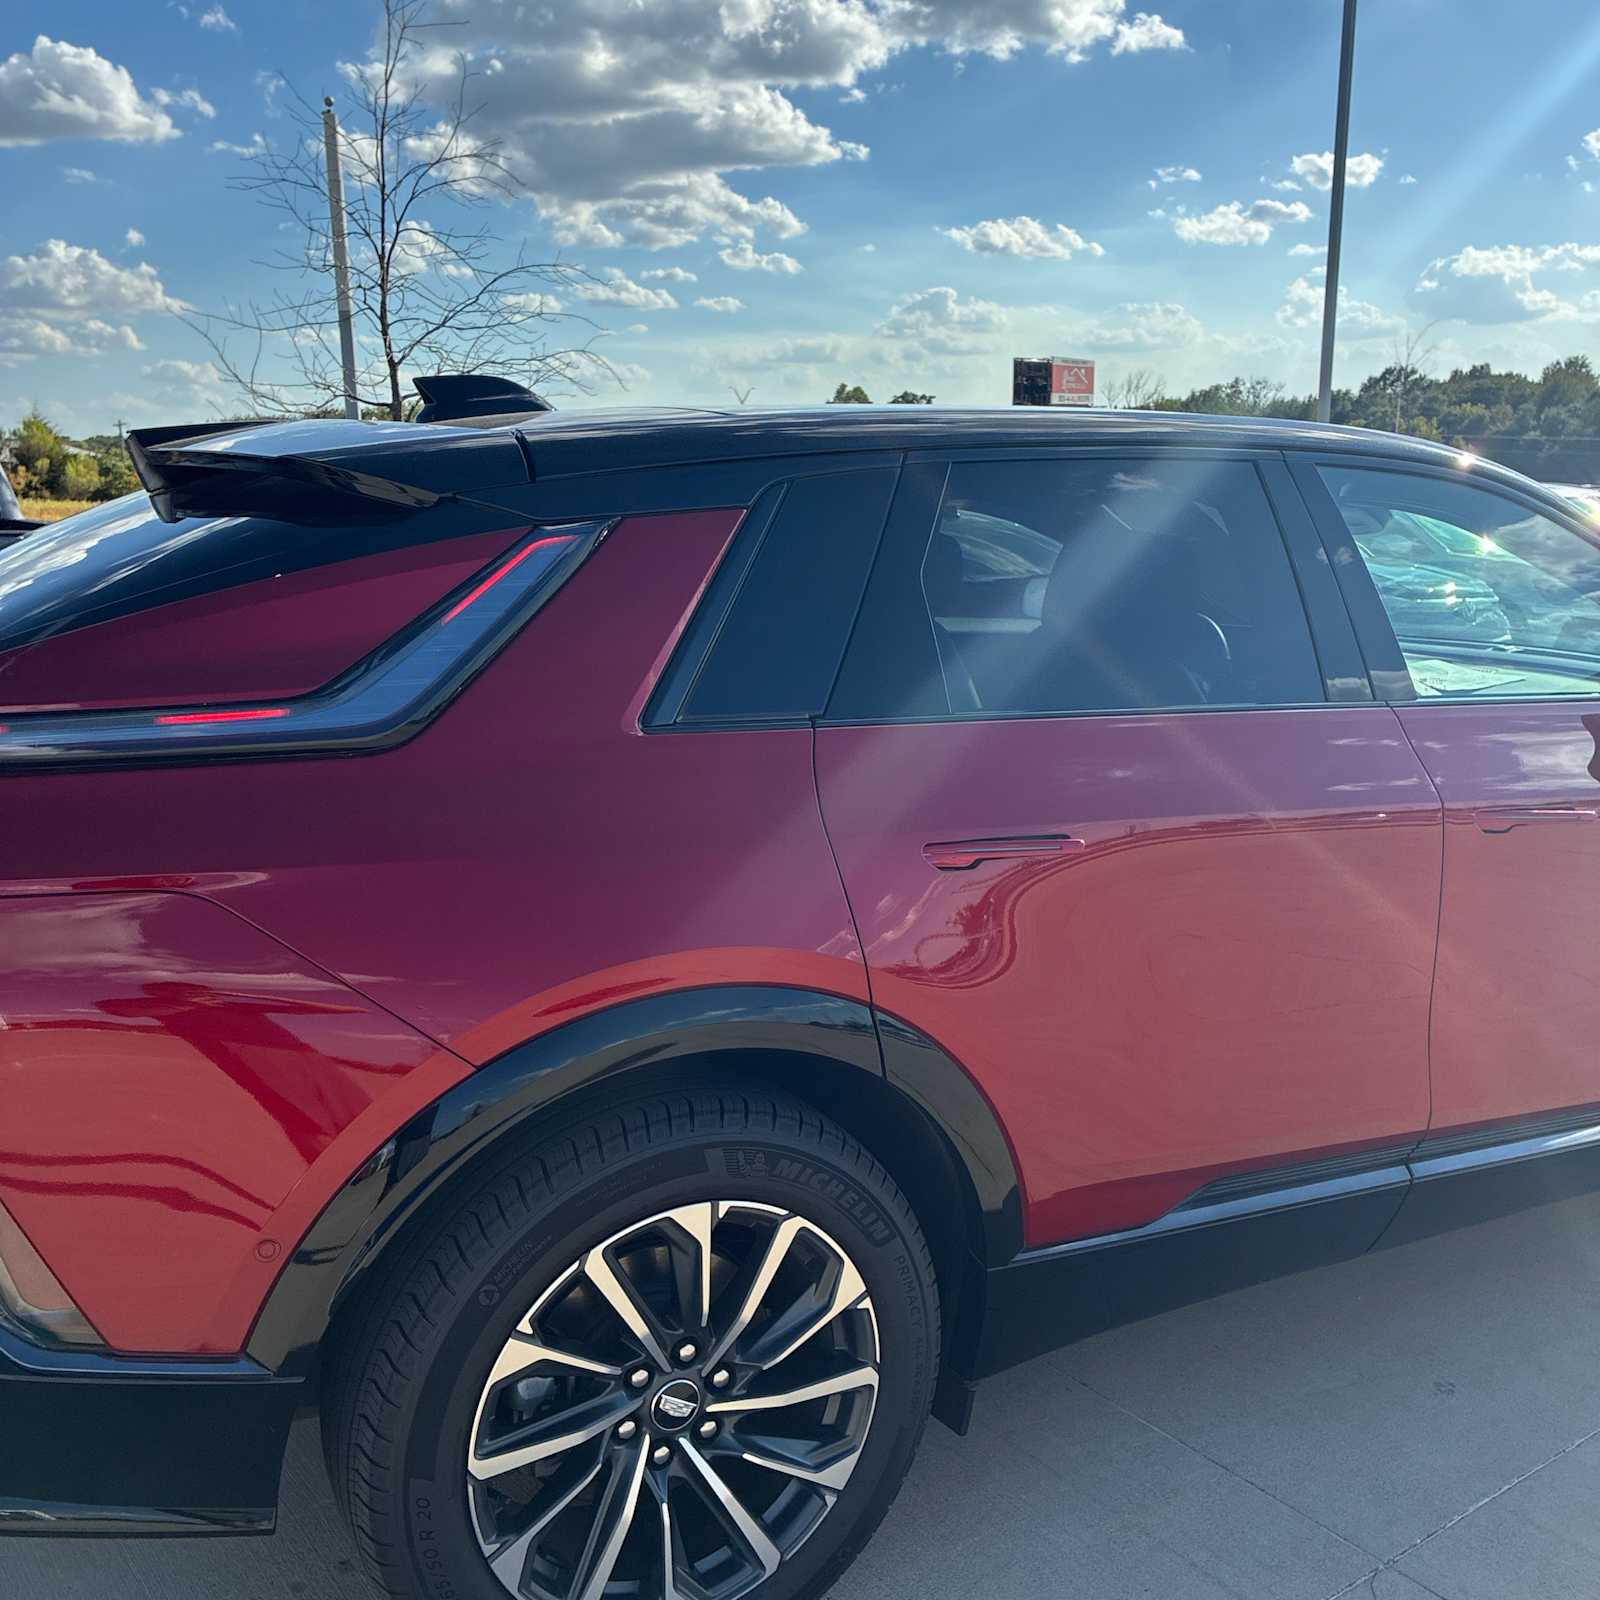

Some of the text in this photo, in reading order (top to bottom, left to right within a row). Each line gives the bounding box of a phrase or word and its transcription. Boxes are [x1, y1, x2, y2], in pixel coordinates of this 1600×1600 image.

[773, 1158, 889, 1242] MICHELIN
[895, 1256, 922, 1328] PRIMACY
[416, 1498, 433, 1520] 20
